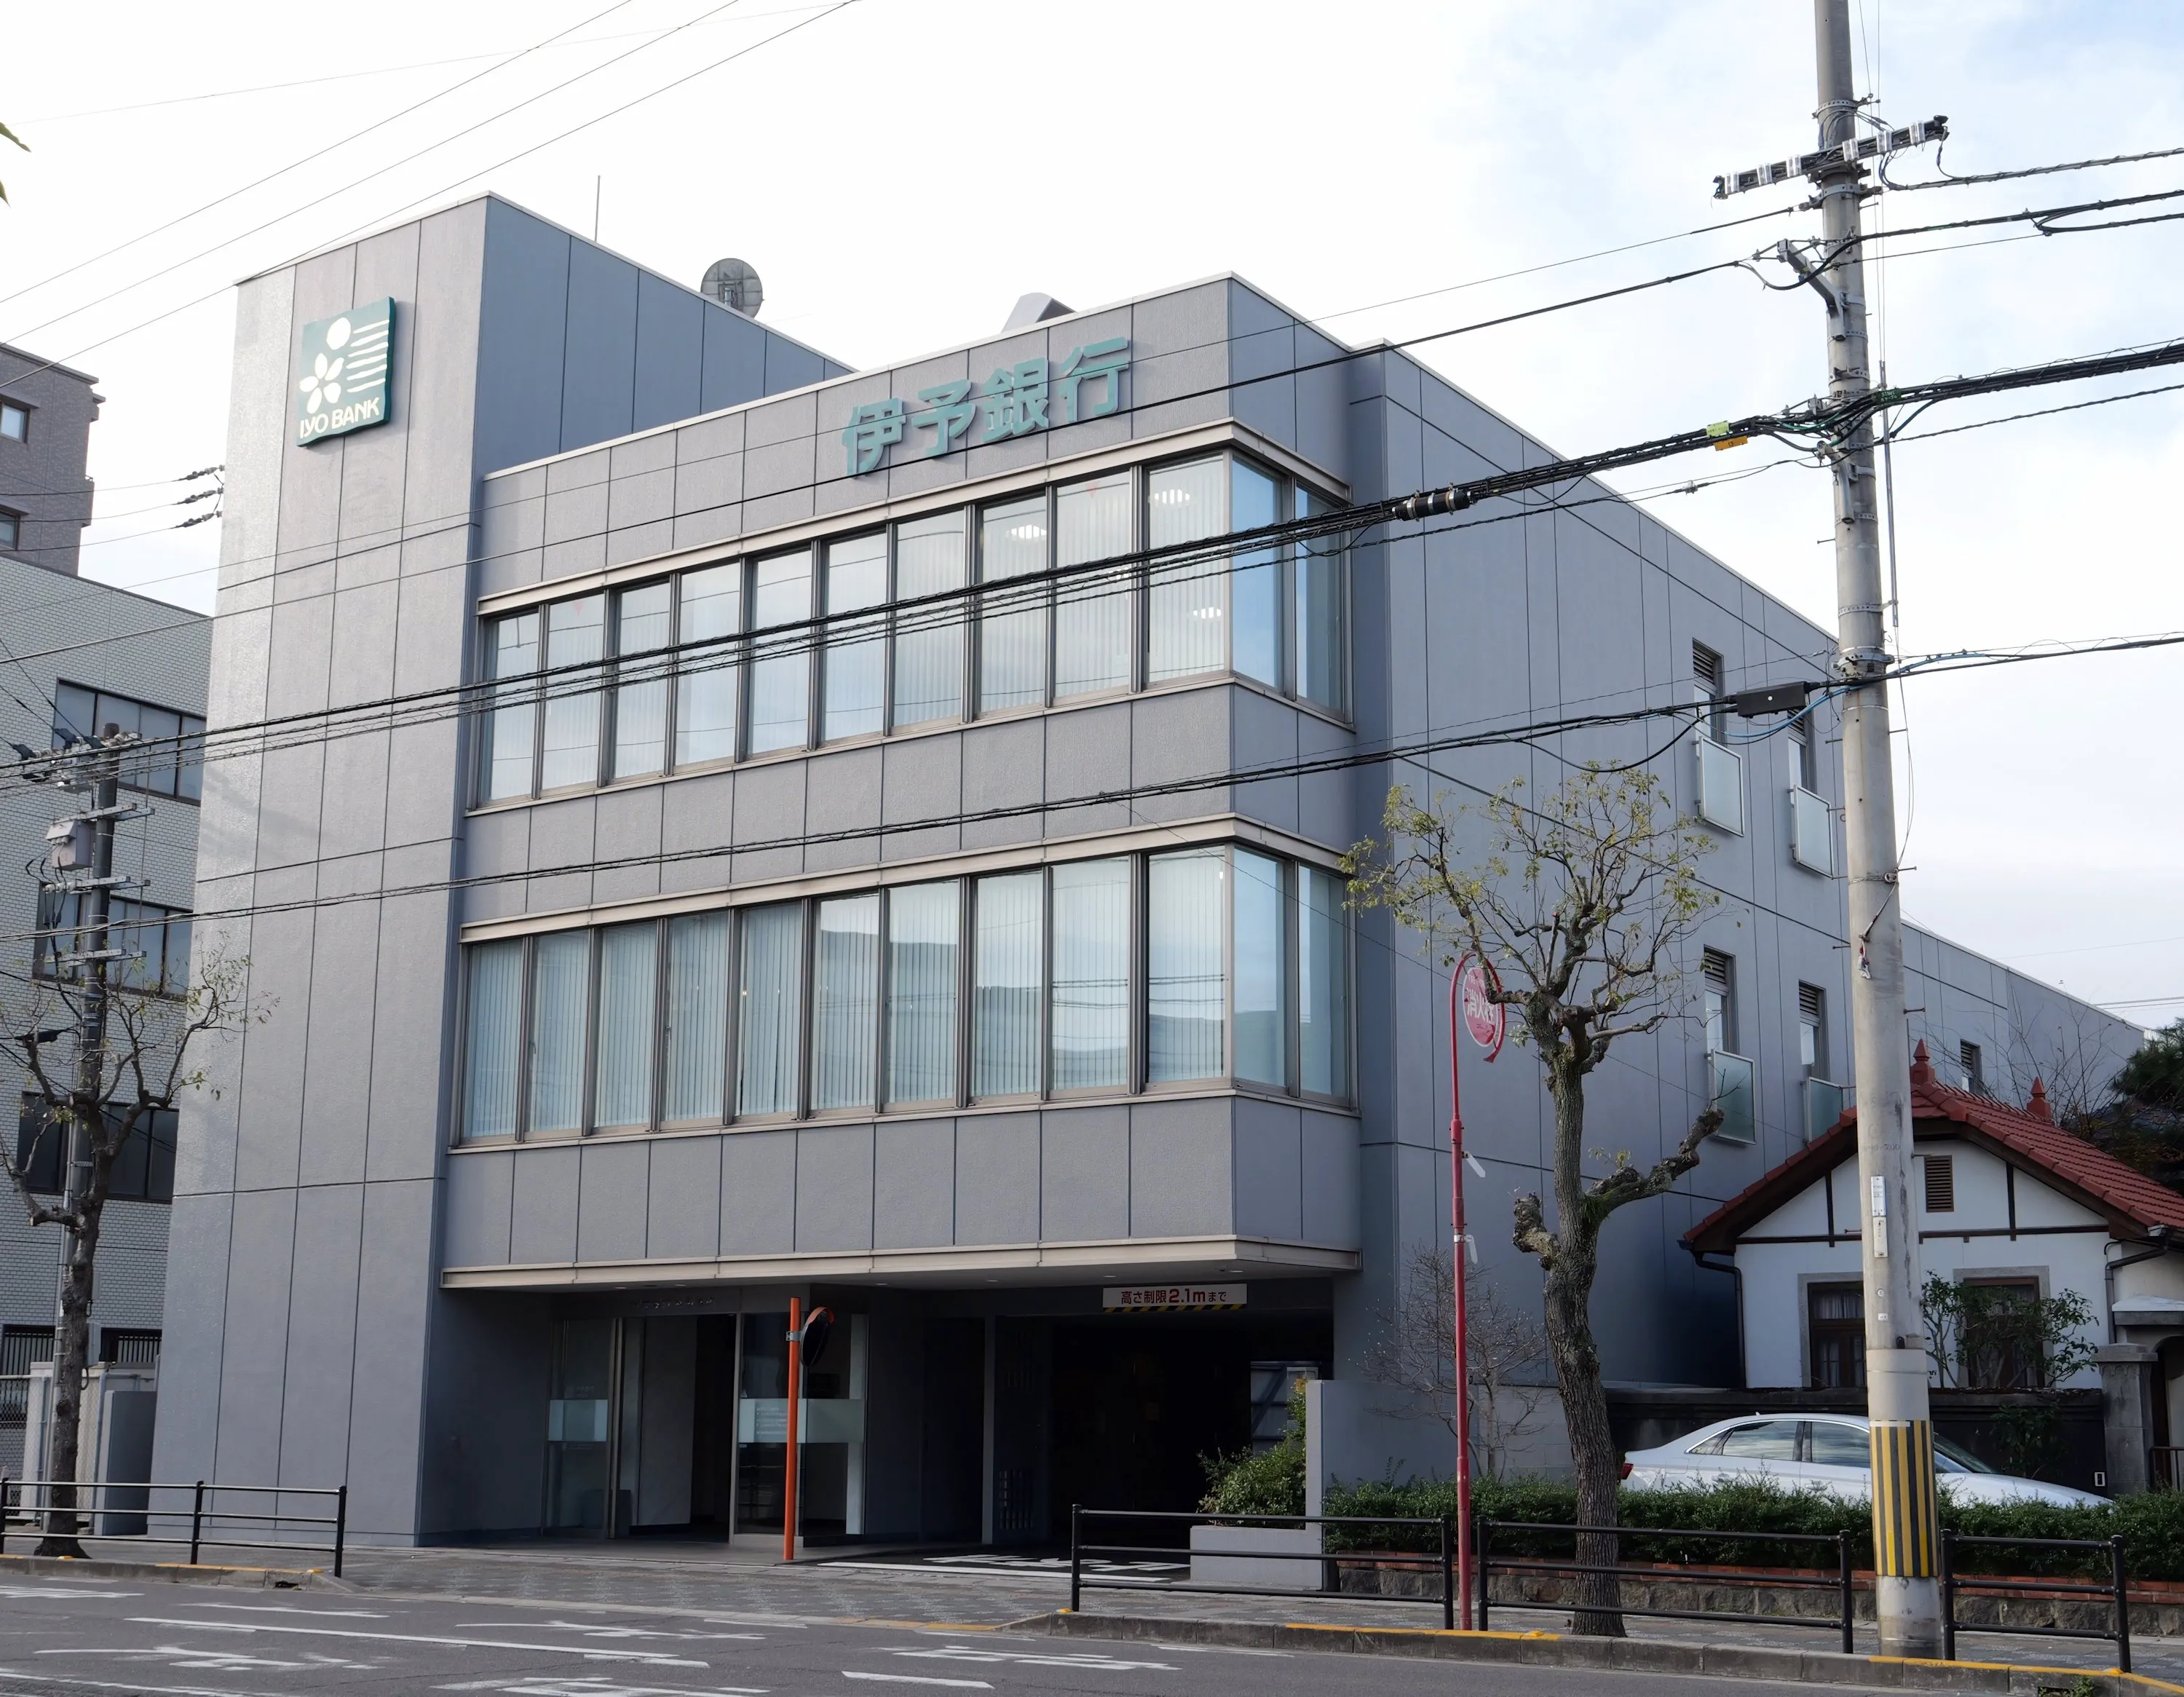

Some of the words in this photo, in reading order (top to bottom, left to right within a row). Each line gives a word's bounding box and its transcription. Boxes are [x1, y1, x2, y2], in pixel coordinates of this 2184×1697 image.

[300, 414, 329, 438] IYO
[332, 397, 379, 428] BANK
[842, 336, 1130, 477] 伊予銀行
[1121, 1288, 1227, 1305] 高さ制限2.1mまで
